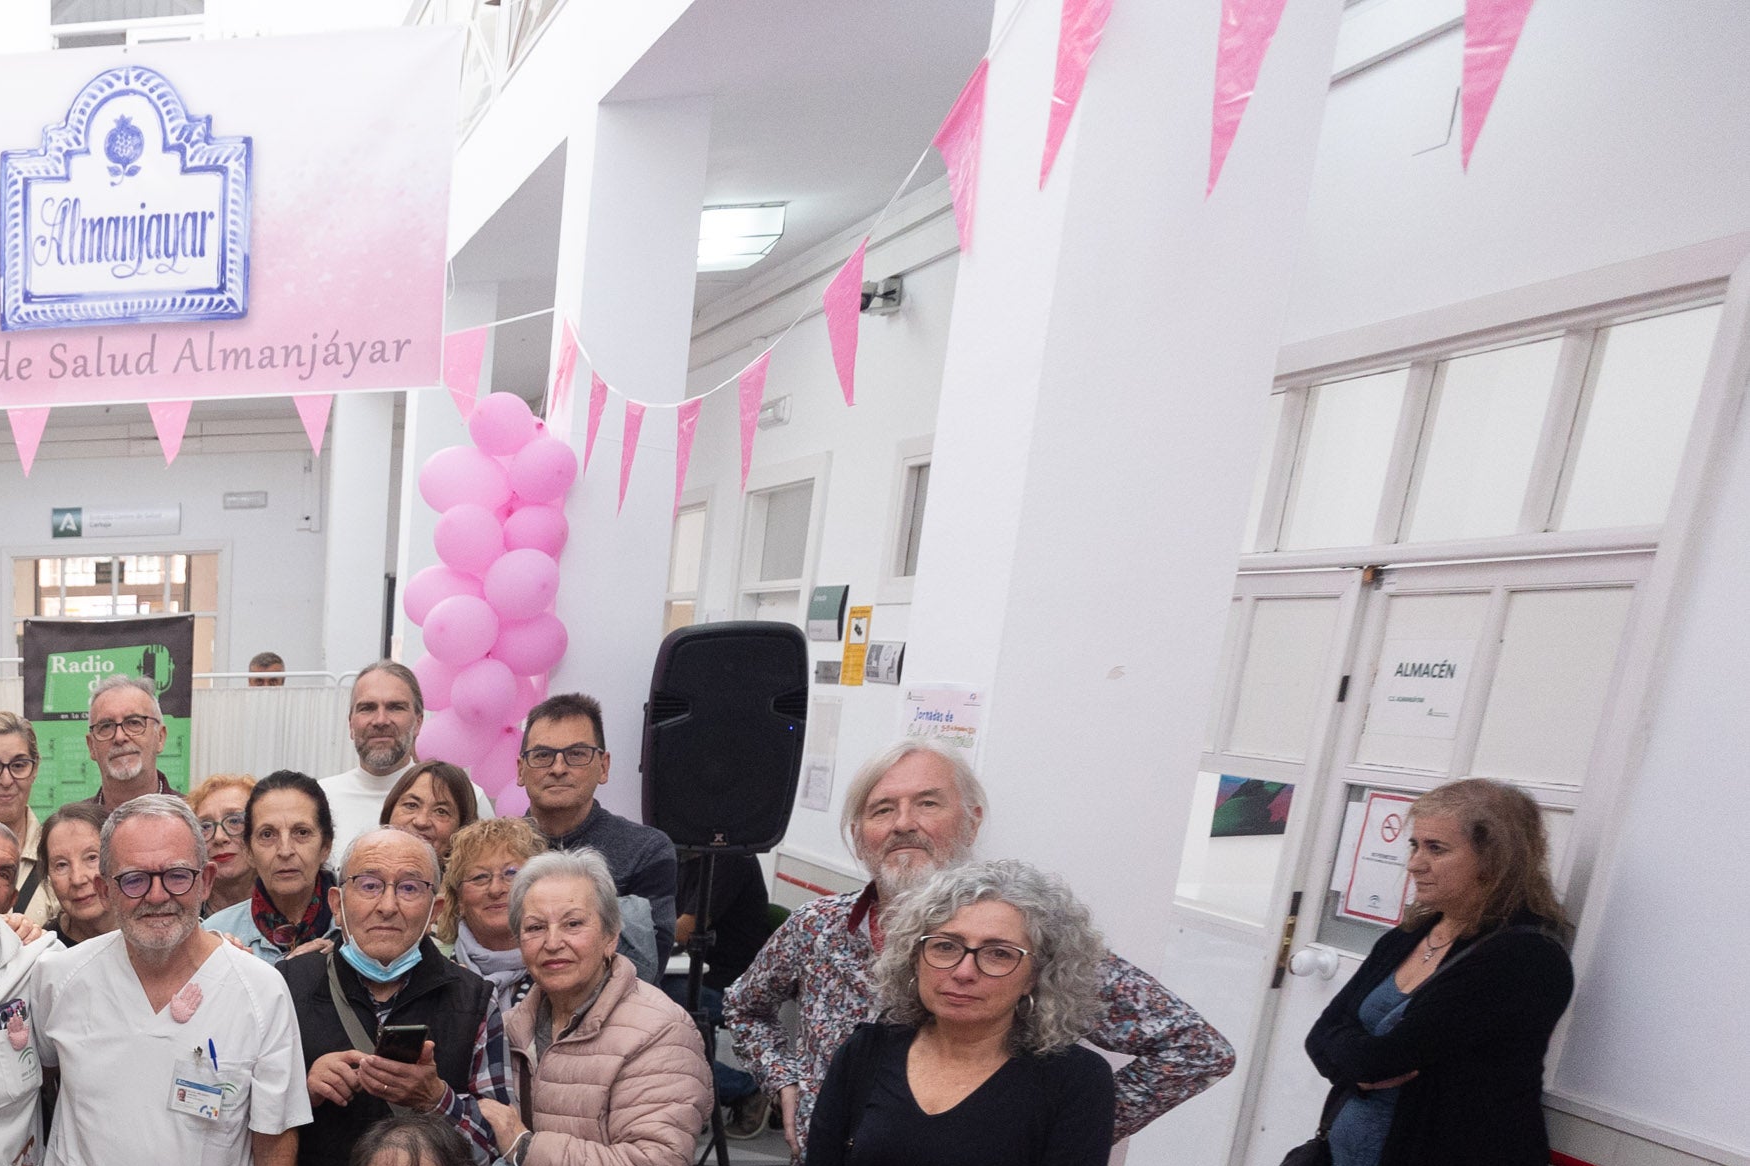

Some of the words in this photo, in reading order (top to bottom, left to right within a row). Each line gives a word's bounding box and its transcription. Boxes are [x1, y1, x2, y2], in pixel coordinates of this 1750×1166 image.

[33, 196, 216, 278] Almanjayar
[48, 333, 157, 380] Salud
[172, 328, 412, 381] Almanjáyar
[51, 655, 115, 674] Radio
[1394, 659, 1457, 679] ALMACÉN
[88, 674, 101, 693] d
[913, 707, 943, 723] Jornadas
[945, 710, 954, 722] de
